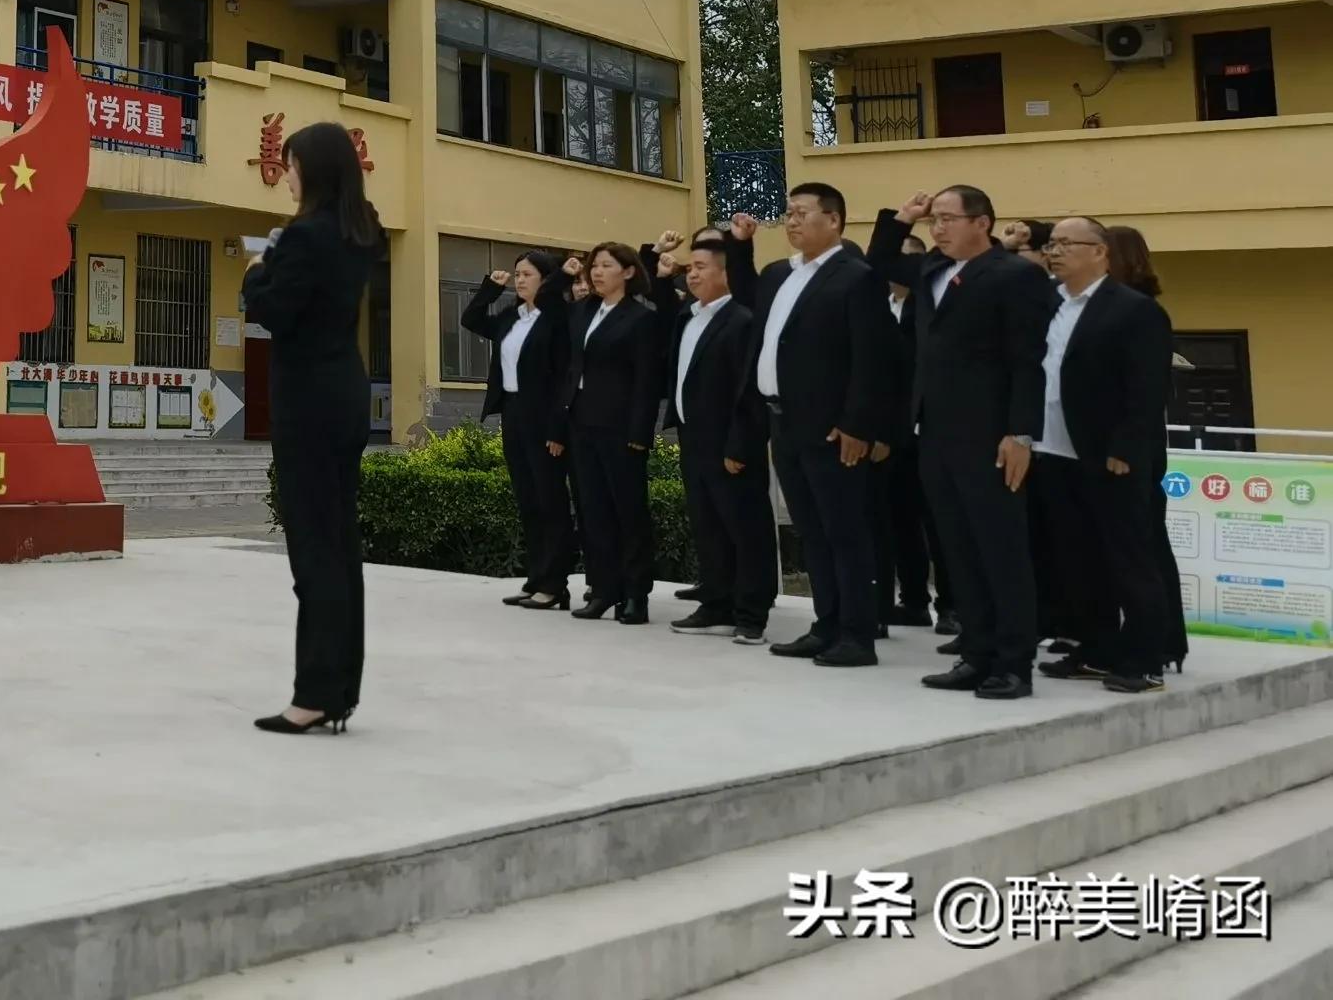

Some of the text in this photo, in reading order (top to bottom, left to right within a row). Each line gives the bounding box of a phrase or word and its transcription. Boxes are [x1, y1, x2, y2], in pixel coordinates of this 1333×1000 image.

[247, 112, 288, 187] 善
[1167, 476, 1312, 501] 六好标准
